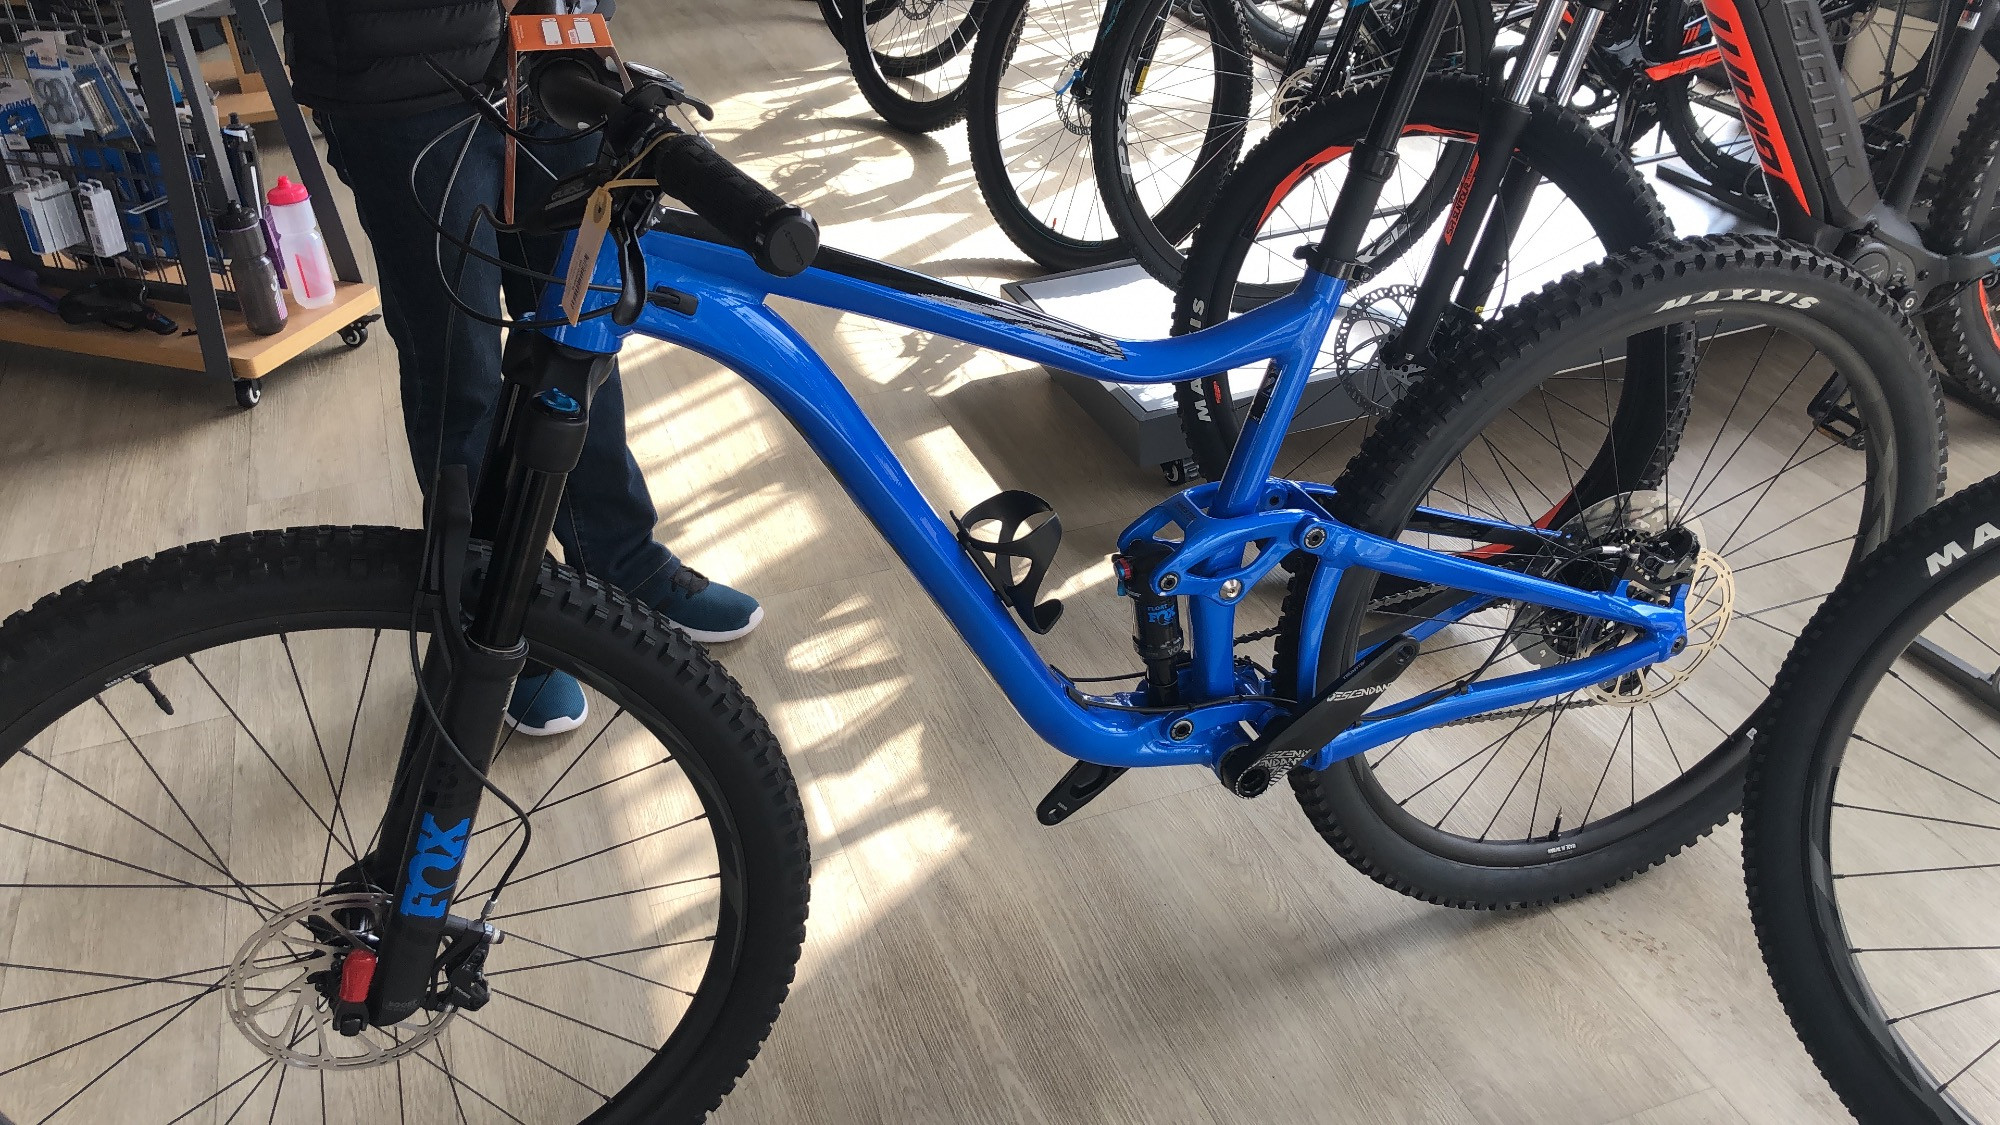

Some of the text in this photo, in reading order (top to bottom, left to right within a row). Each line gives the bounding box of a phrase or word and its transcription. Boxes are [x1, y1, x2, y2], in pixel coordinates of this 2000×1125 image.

[1653, 288, 1820, 314] MAXXIS
[1147, 603, 1168, 612] FLOAT
[1147, 604, 1176, 626] FOX
[400, 811, 471, 919] FOX
